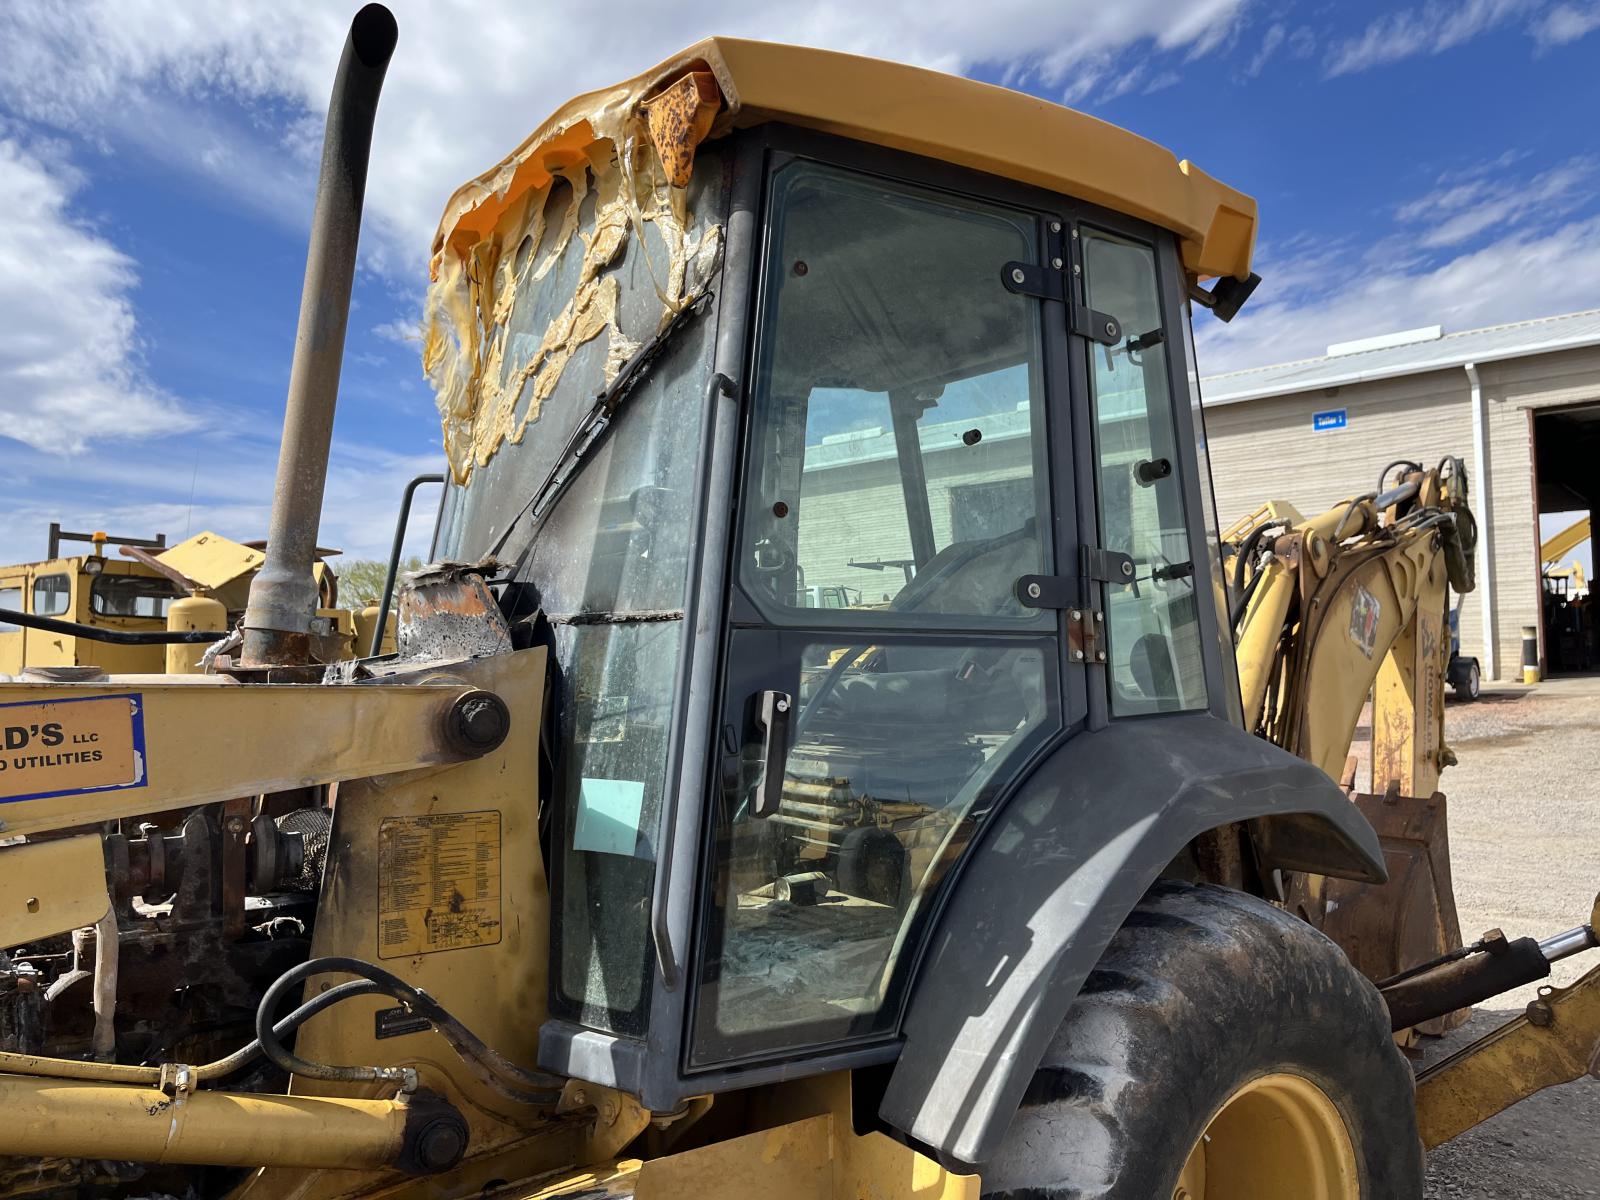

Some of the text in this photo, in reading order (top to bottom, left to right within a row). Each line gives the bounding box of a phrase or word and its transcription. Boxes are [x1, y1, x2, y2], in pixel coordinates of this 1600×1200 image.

[0, 723, 98, 750] D'S LLC
[14, 751, 102, 769] UTILITIES
